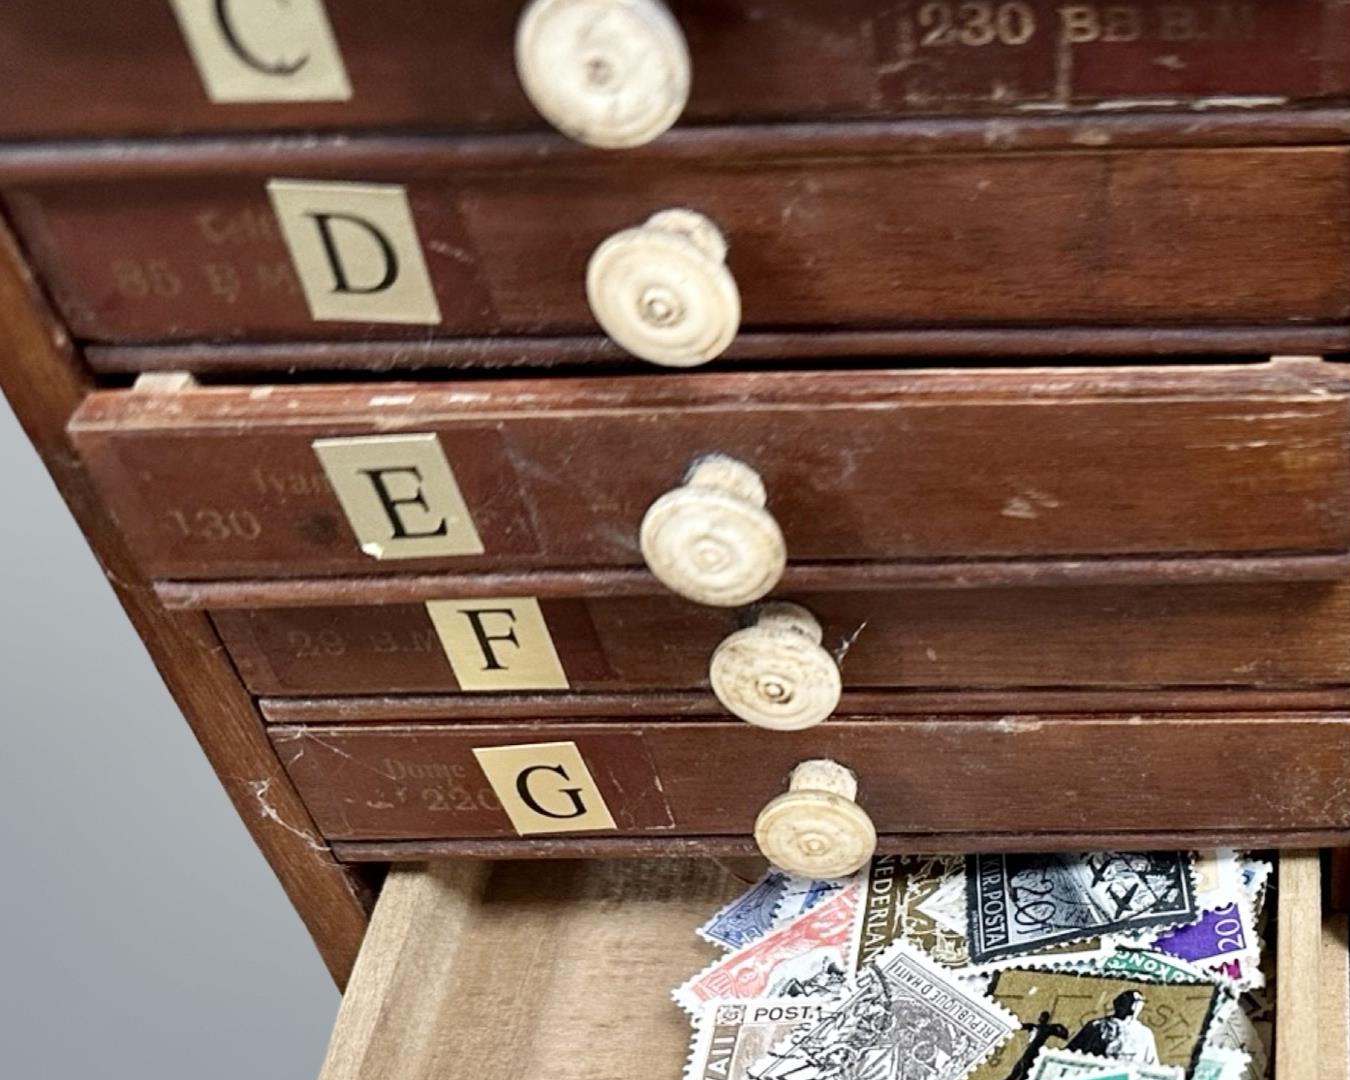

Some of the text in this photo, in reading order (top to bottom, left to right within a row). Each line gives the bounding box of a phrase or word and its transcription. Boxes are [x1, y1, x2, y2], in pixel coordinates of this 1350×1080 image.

[919, 2, 1034, 46] 230
[304, 212, 399, 296] D
[358, 466, 448, 540] E
[458, 608, 520, 671] F
[516, 764, 588, 820] G
[935, 991, 997, 1038] REPUBLIQUE
